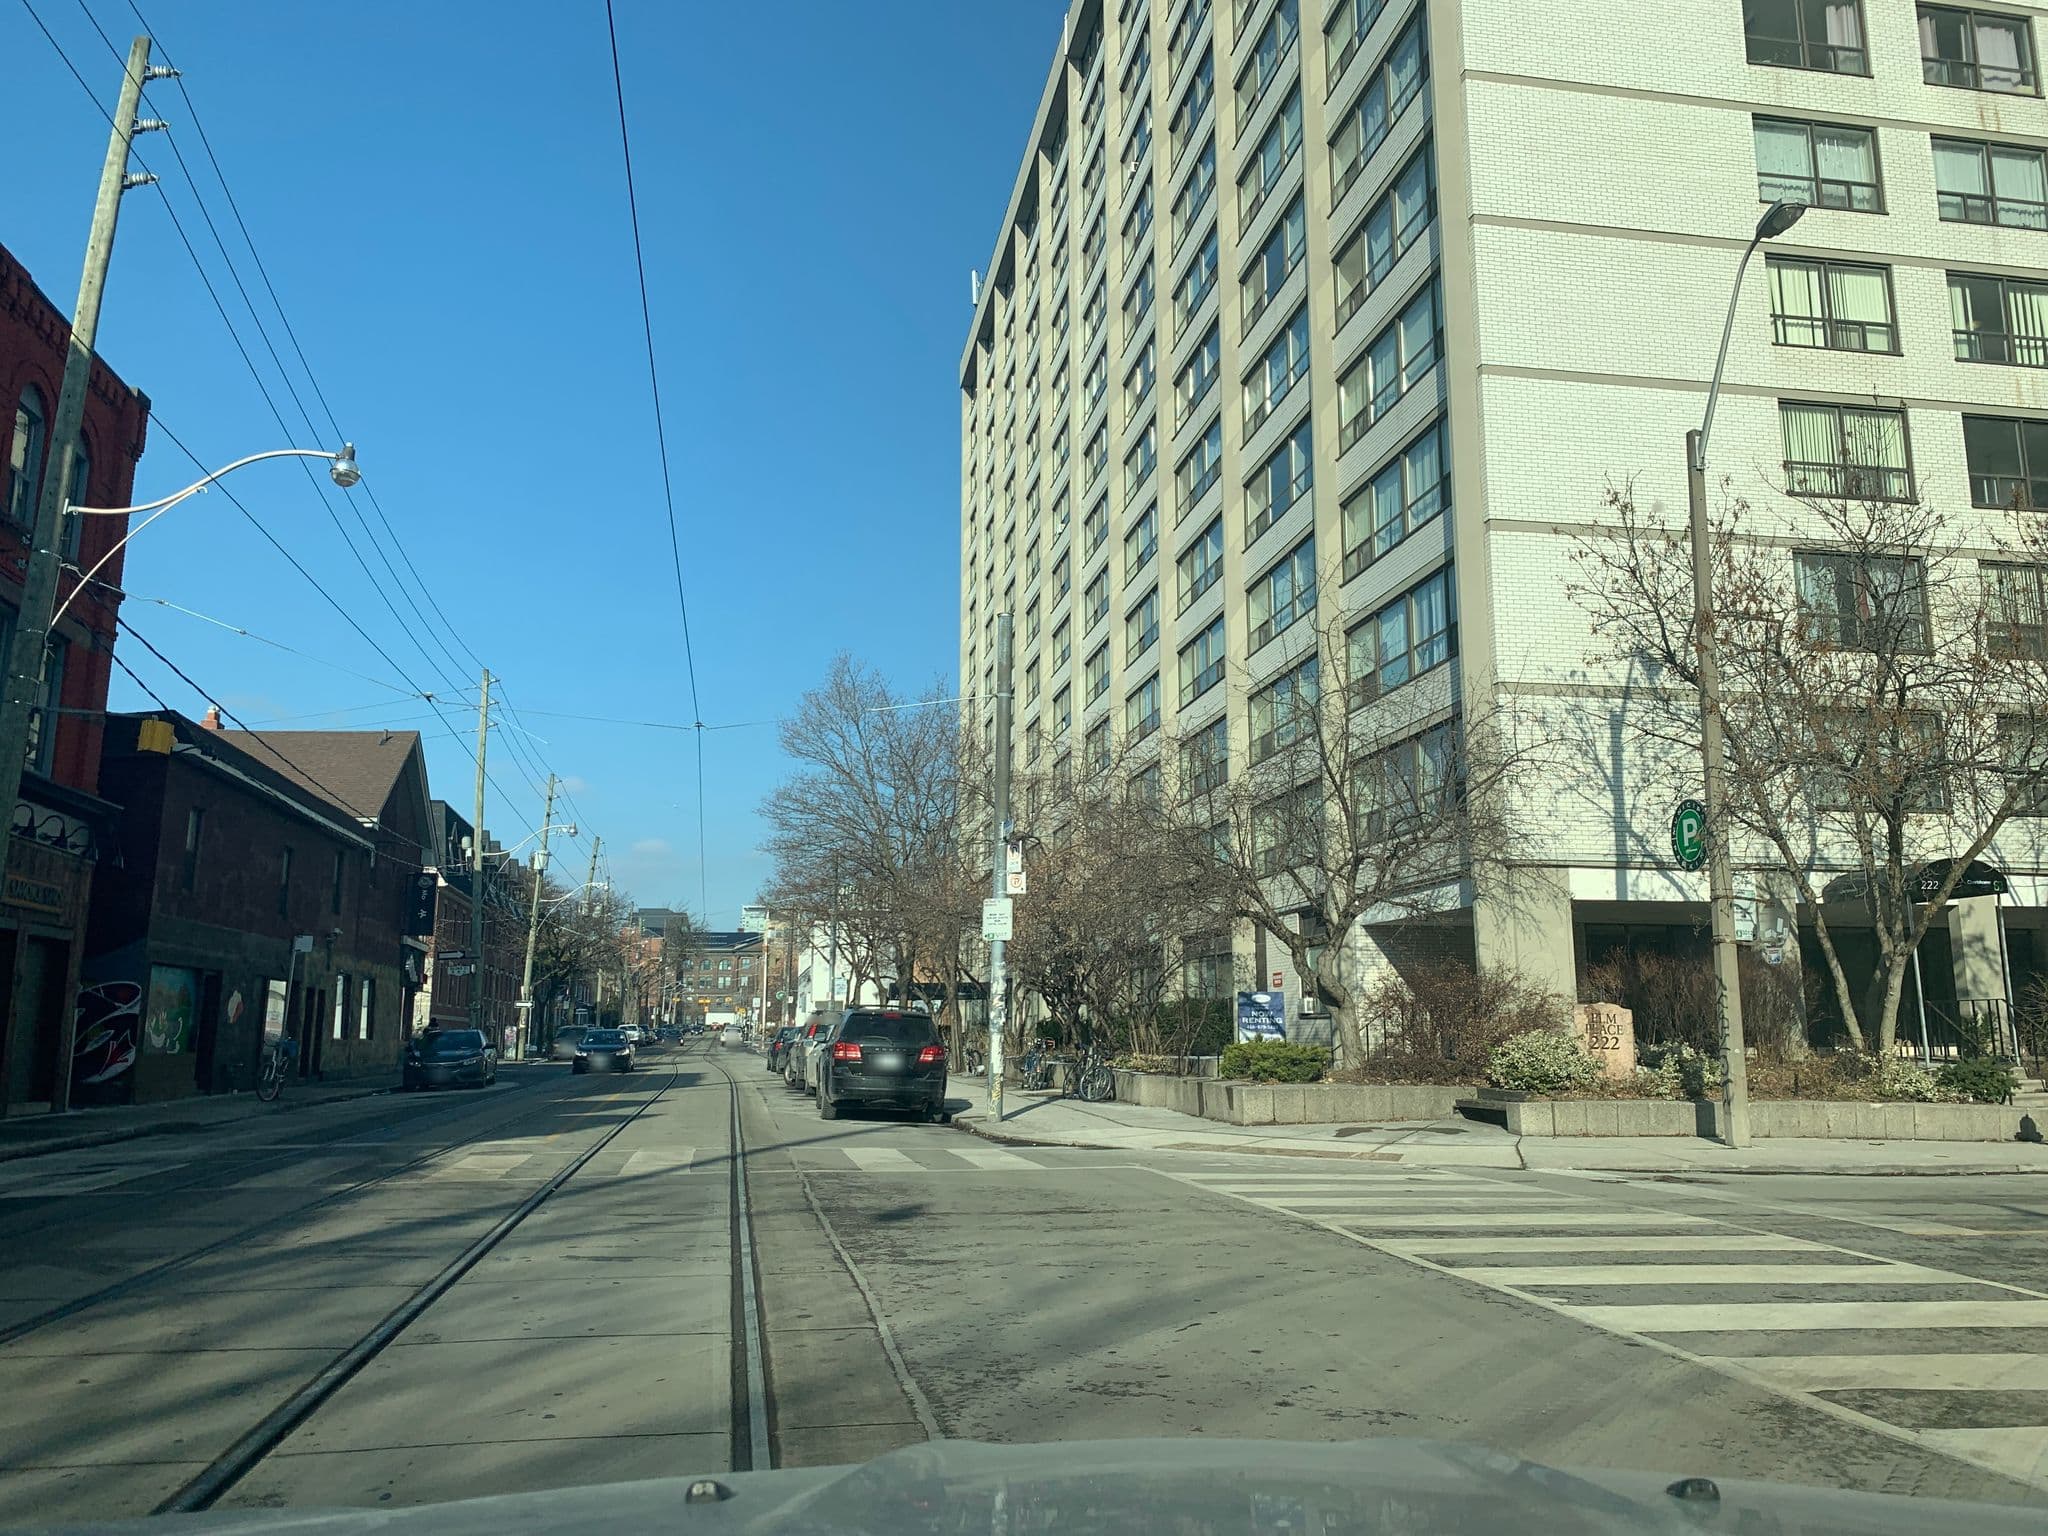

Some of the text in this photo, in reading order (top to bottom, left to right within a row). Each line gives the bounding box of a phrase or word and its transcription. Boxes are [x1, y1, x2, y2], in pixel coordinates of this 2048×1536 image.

[1682, 818, 1698, 847] P
[1921, 880, 1939, 890] 222
[1591, 1013, 1617, 1024] ELM
[1585, 1024, 1624, 1036] PLACE
[1590, 1036, 1620, 1050] 222
